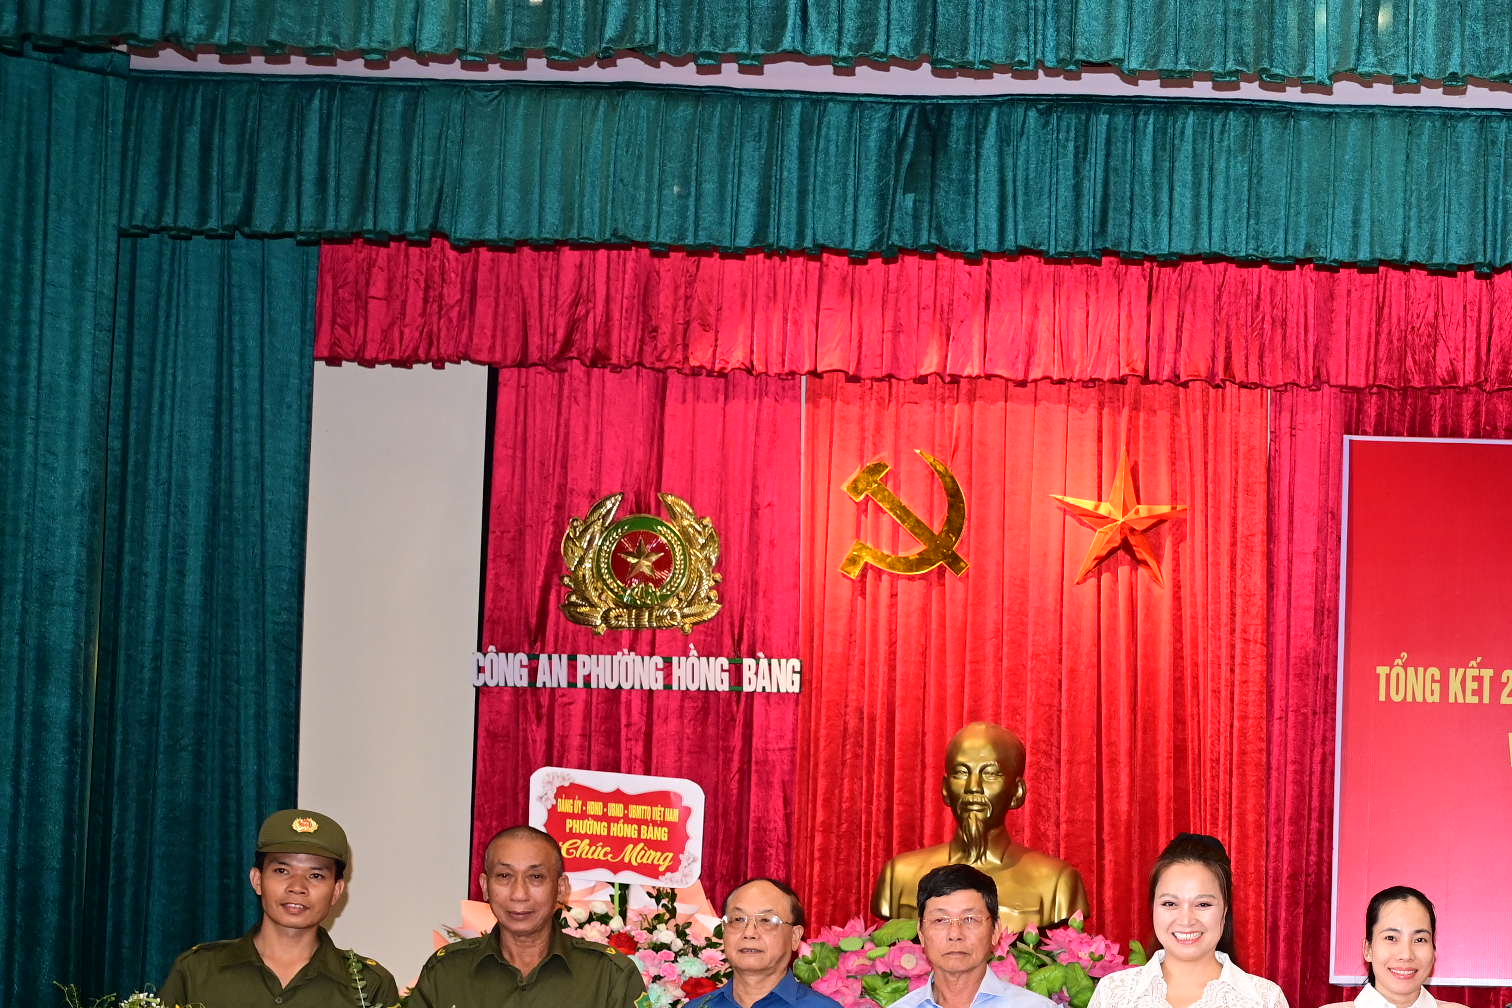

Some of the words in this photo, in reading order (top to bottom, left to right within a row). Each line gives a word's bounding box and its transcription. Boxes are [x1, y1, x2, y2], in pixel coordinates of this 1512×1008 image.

[472, 645, 529, 688] CÔNG
[536, 654, 569, 688] AN
[576, 648, 664, 690] PHƯỜNG
[672, 643, 730, 691] HỒNG
[742, 652, 801, 693] BÀNG
[1377, 653, 1440, 702] TỔNG
[1449, 656, 1495, 704] KẾT
[565, 816, 608, 836] PHƯỜNG
[640, 823, 669, 841] BÀNG
[652, 804, 665, 824] VIỆT
[665, 808, 680, 823] NAM
[559, 838, 611, 861] Chúc
[608, 842, 674, 872] Mừng
